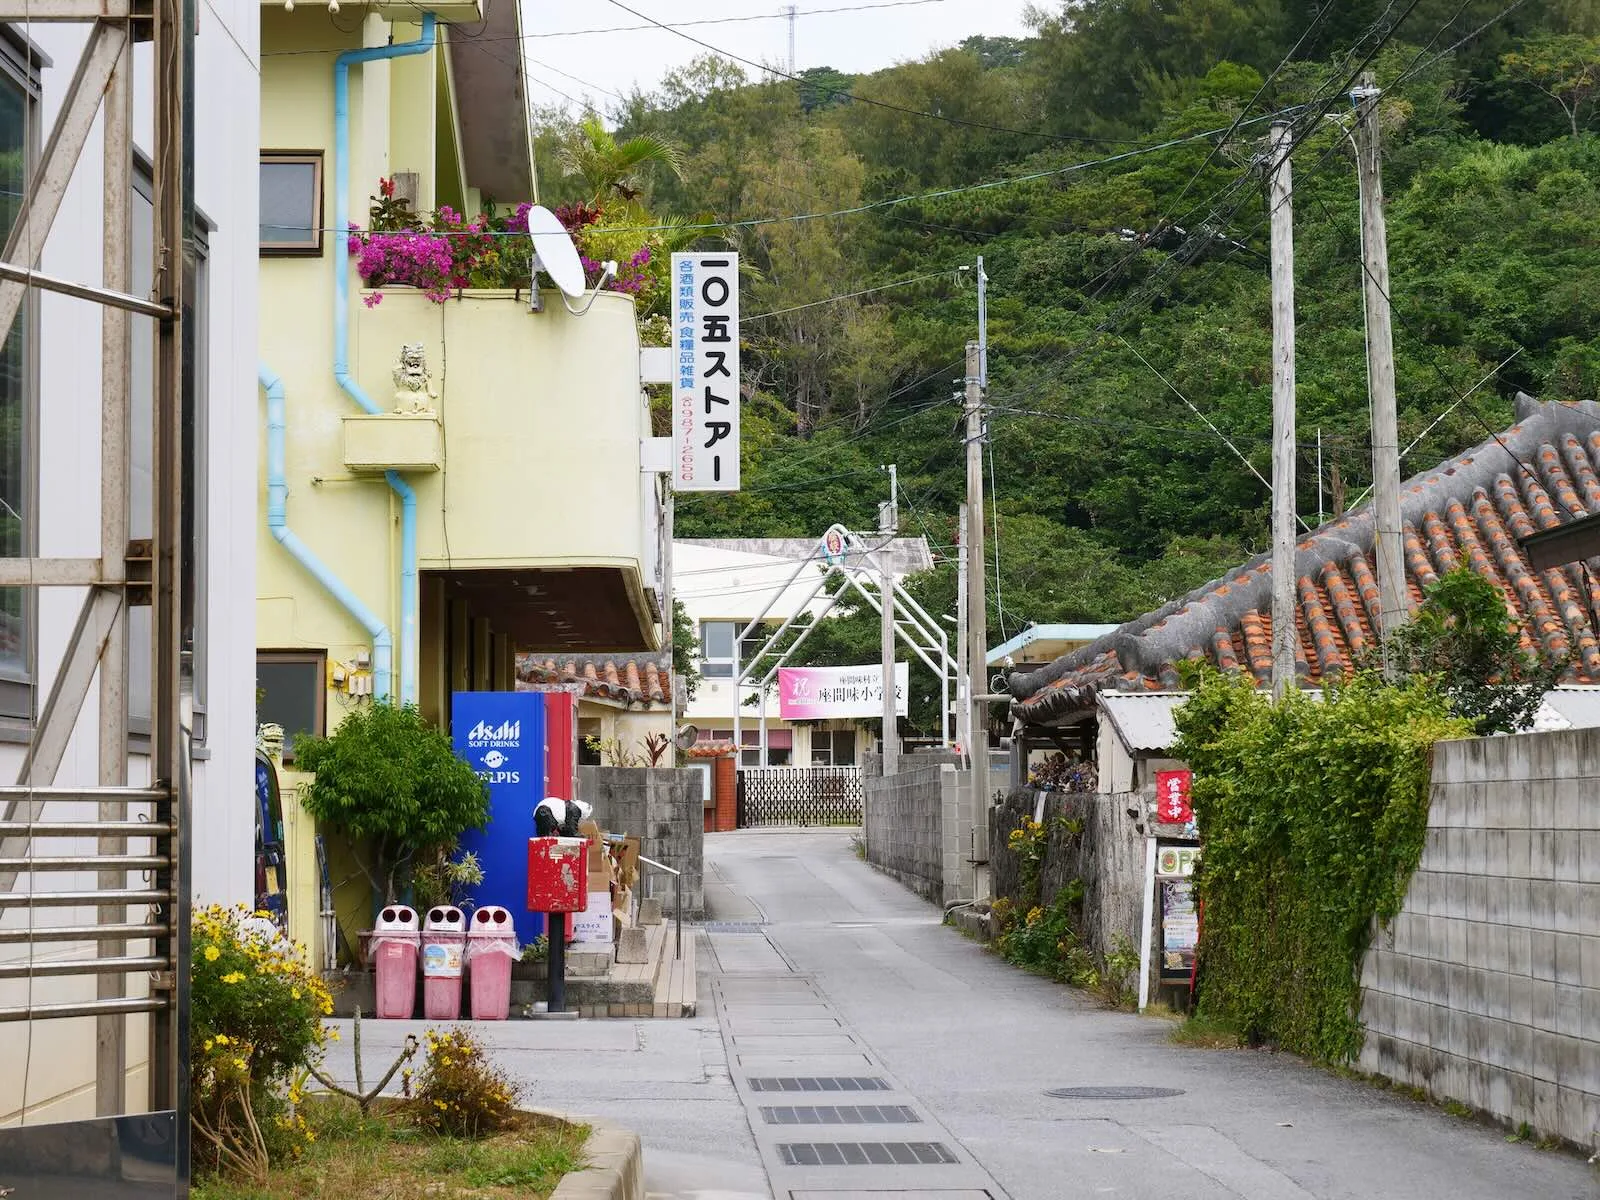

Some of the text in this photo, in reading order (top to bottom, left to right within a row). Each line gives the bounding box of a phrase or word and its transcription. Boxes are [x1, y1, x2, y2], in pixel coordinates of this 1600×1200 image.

[679, 260, 695, 389] 各酒類販売 食糧品雑貨
[468, 720, 520, 740] Asahi
[468, 740, 520, 748] SOFT DRINKS
[1167, 777, 1182, 818] 営業中
